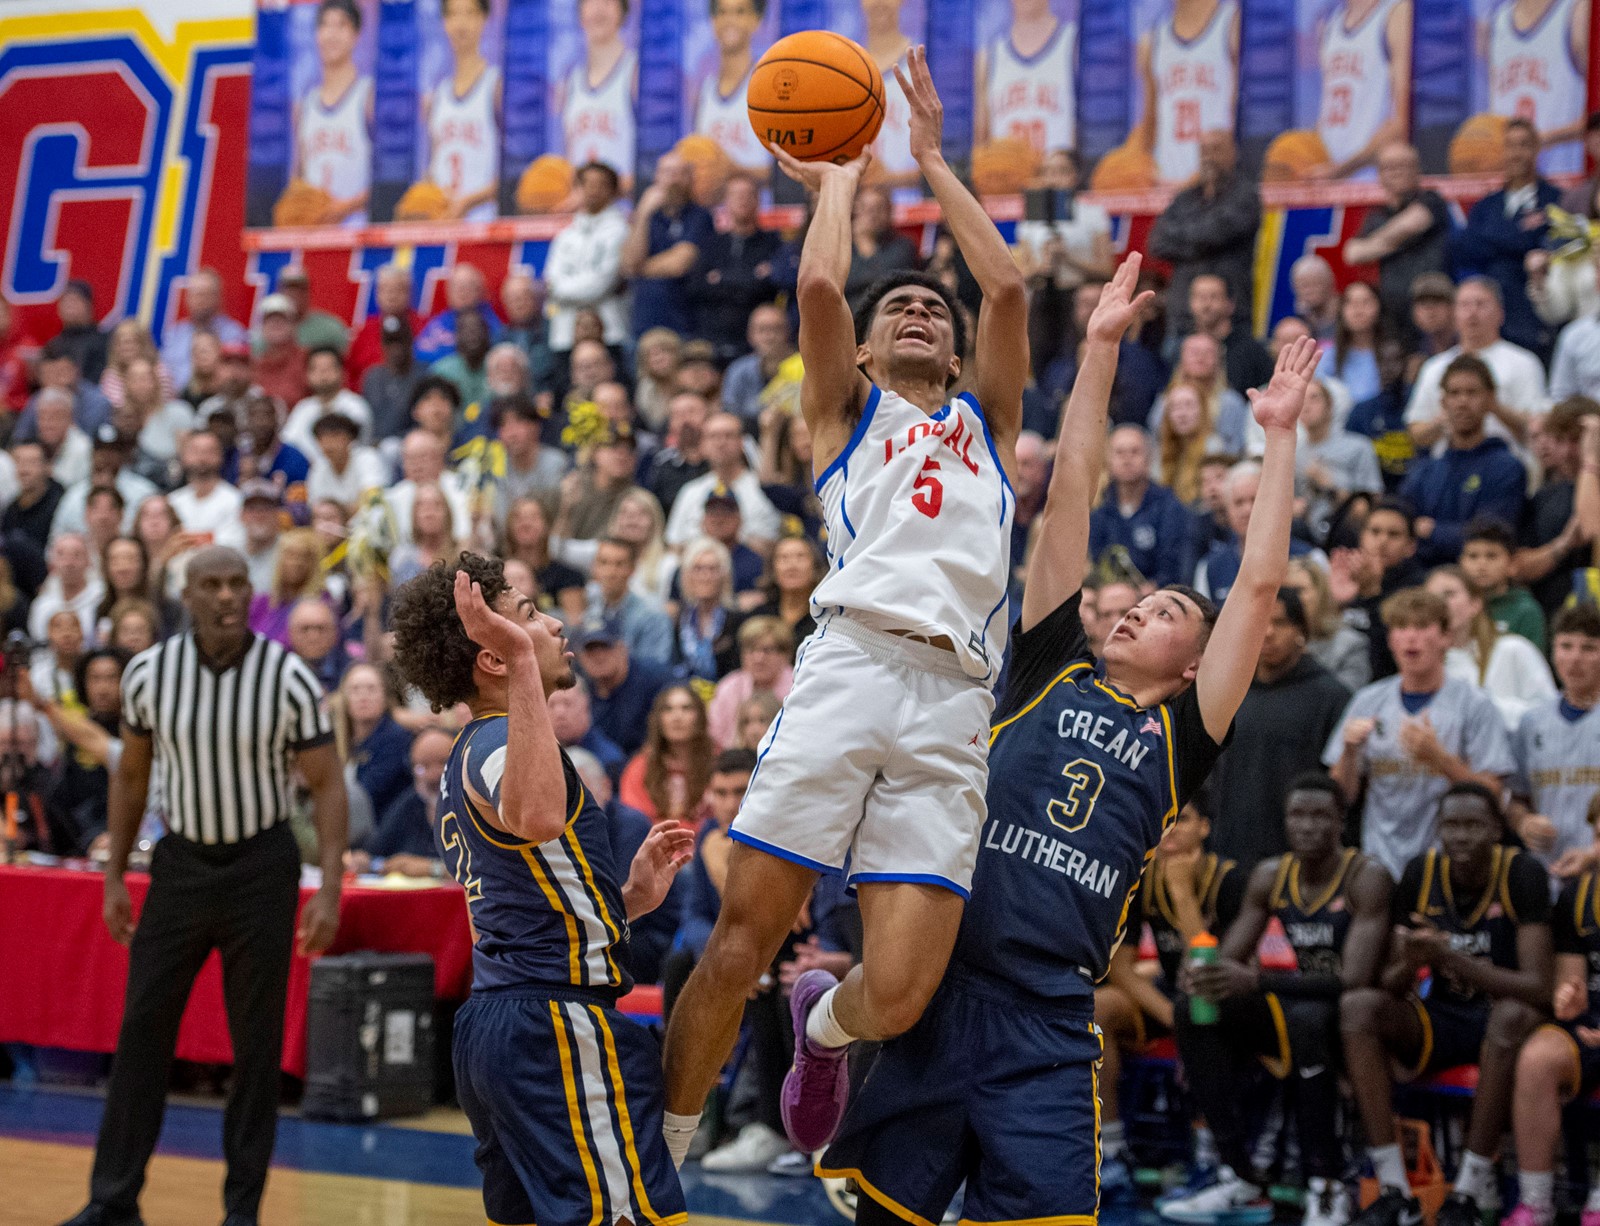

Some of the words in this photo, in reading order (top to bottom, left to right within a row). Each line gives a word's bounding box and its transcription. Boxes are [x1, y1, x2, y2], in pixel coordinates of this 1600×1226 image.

[911, 455, 943, 519] 5
[1058, 709, 1149, 771] CREAN
[1046, 758, 1105, 833] 3
[441, 811, 486, 903] 2
[985, 820, 1120, 899] LUTHERAN
